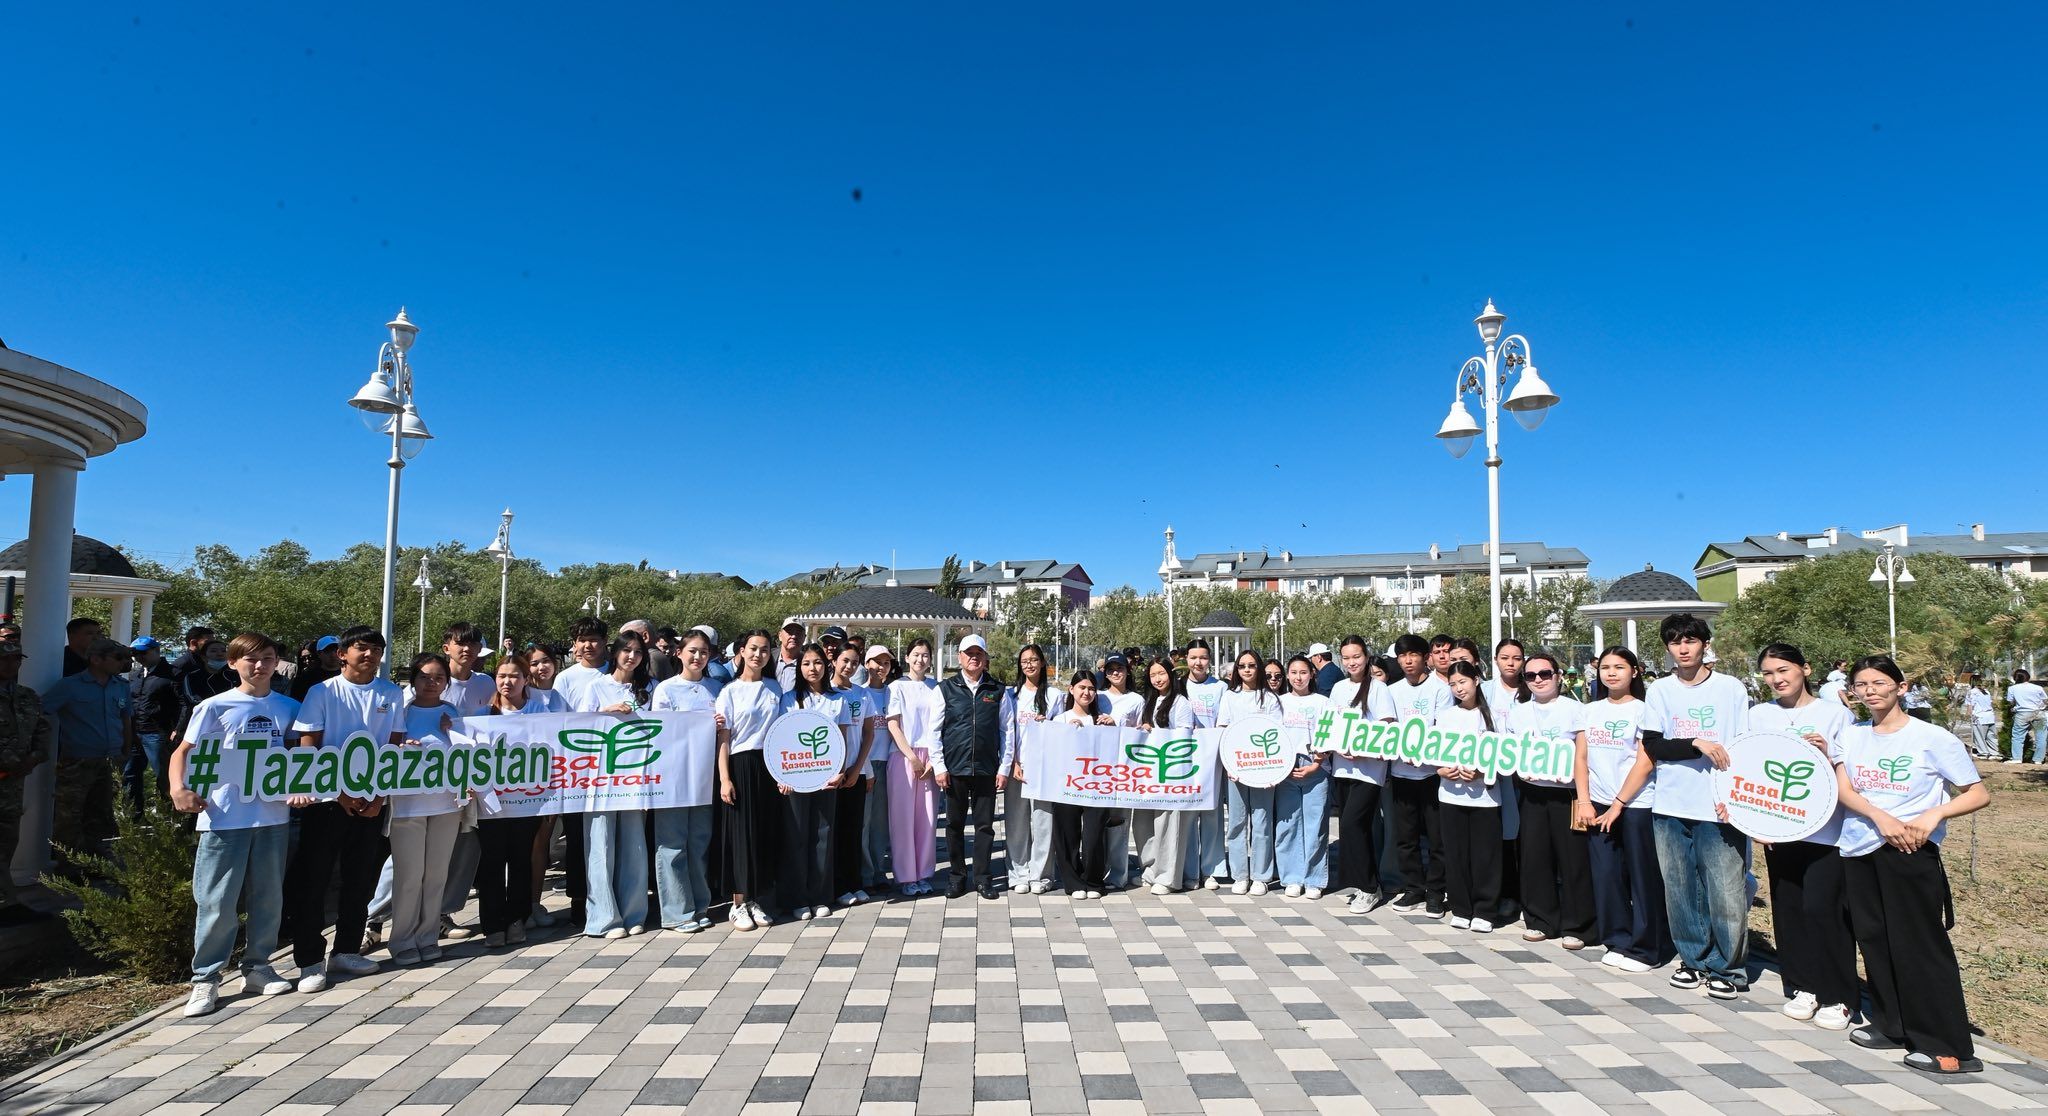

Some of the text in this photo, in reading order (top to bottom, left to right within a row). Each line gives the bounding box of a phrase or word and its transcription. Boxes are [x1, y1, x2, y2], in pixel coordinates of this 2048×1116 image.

[1235, 750, 1266, 760] Таза
[1341, 712, 1574, 779] TazaQazaqstan
[550, 755, 600, 775] за
[780, 751, 813, 762] Таза
[781, 759, 832, 770] Қазақстан
[1236, 758, 1284, 768] Қазақстан
[236, 735, 550, 800] TazaQazaqstan
[1075, 757, 1153, 782] Таза
[1855, 765, 1888, 782] Таза
[1066, 774, 1201, 795] Қазақстан
[1732, 775, 1779, 799] Таза
[1729, 789, 1807, 818] Қазақстан
